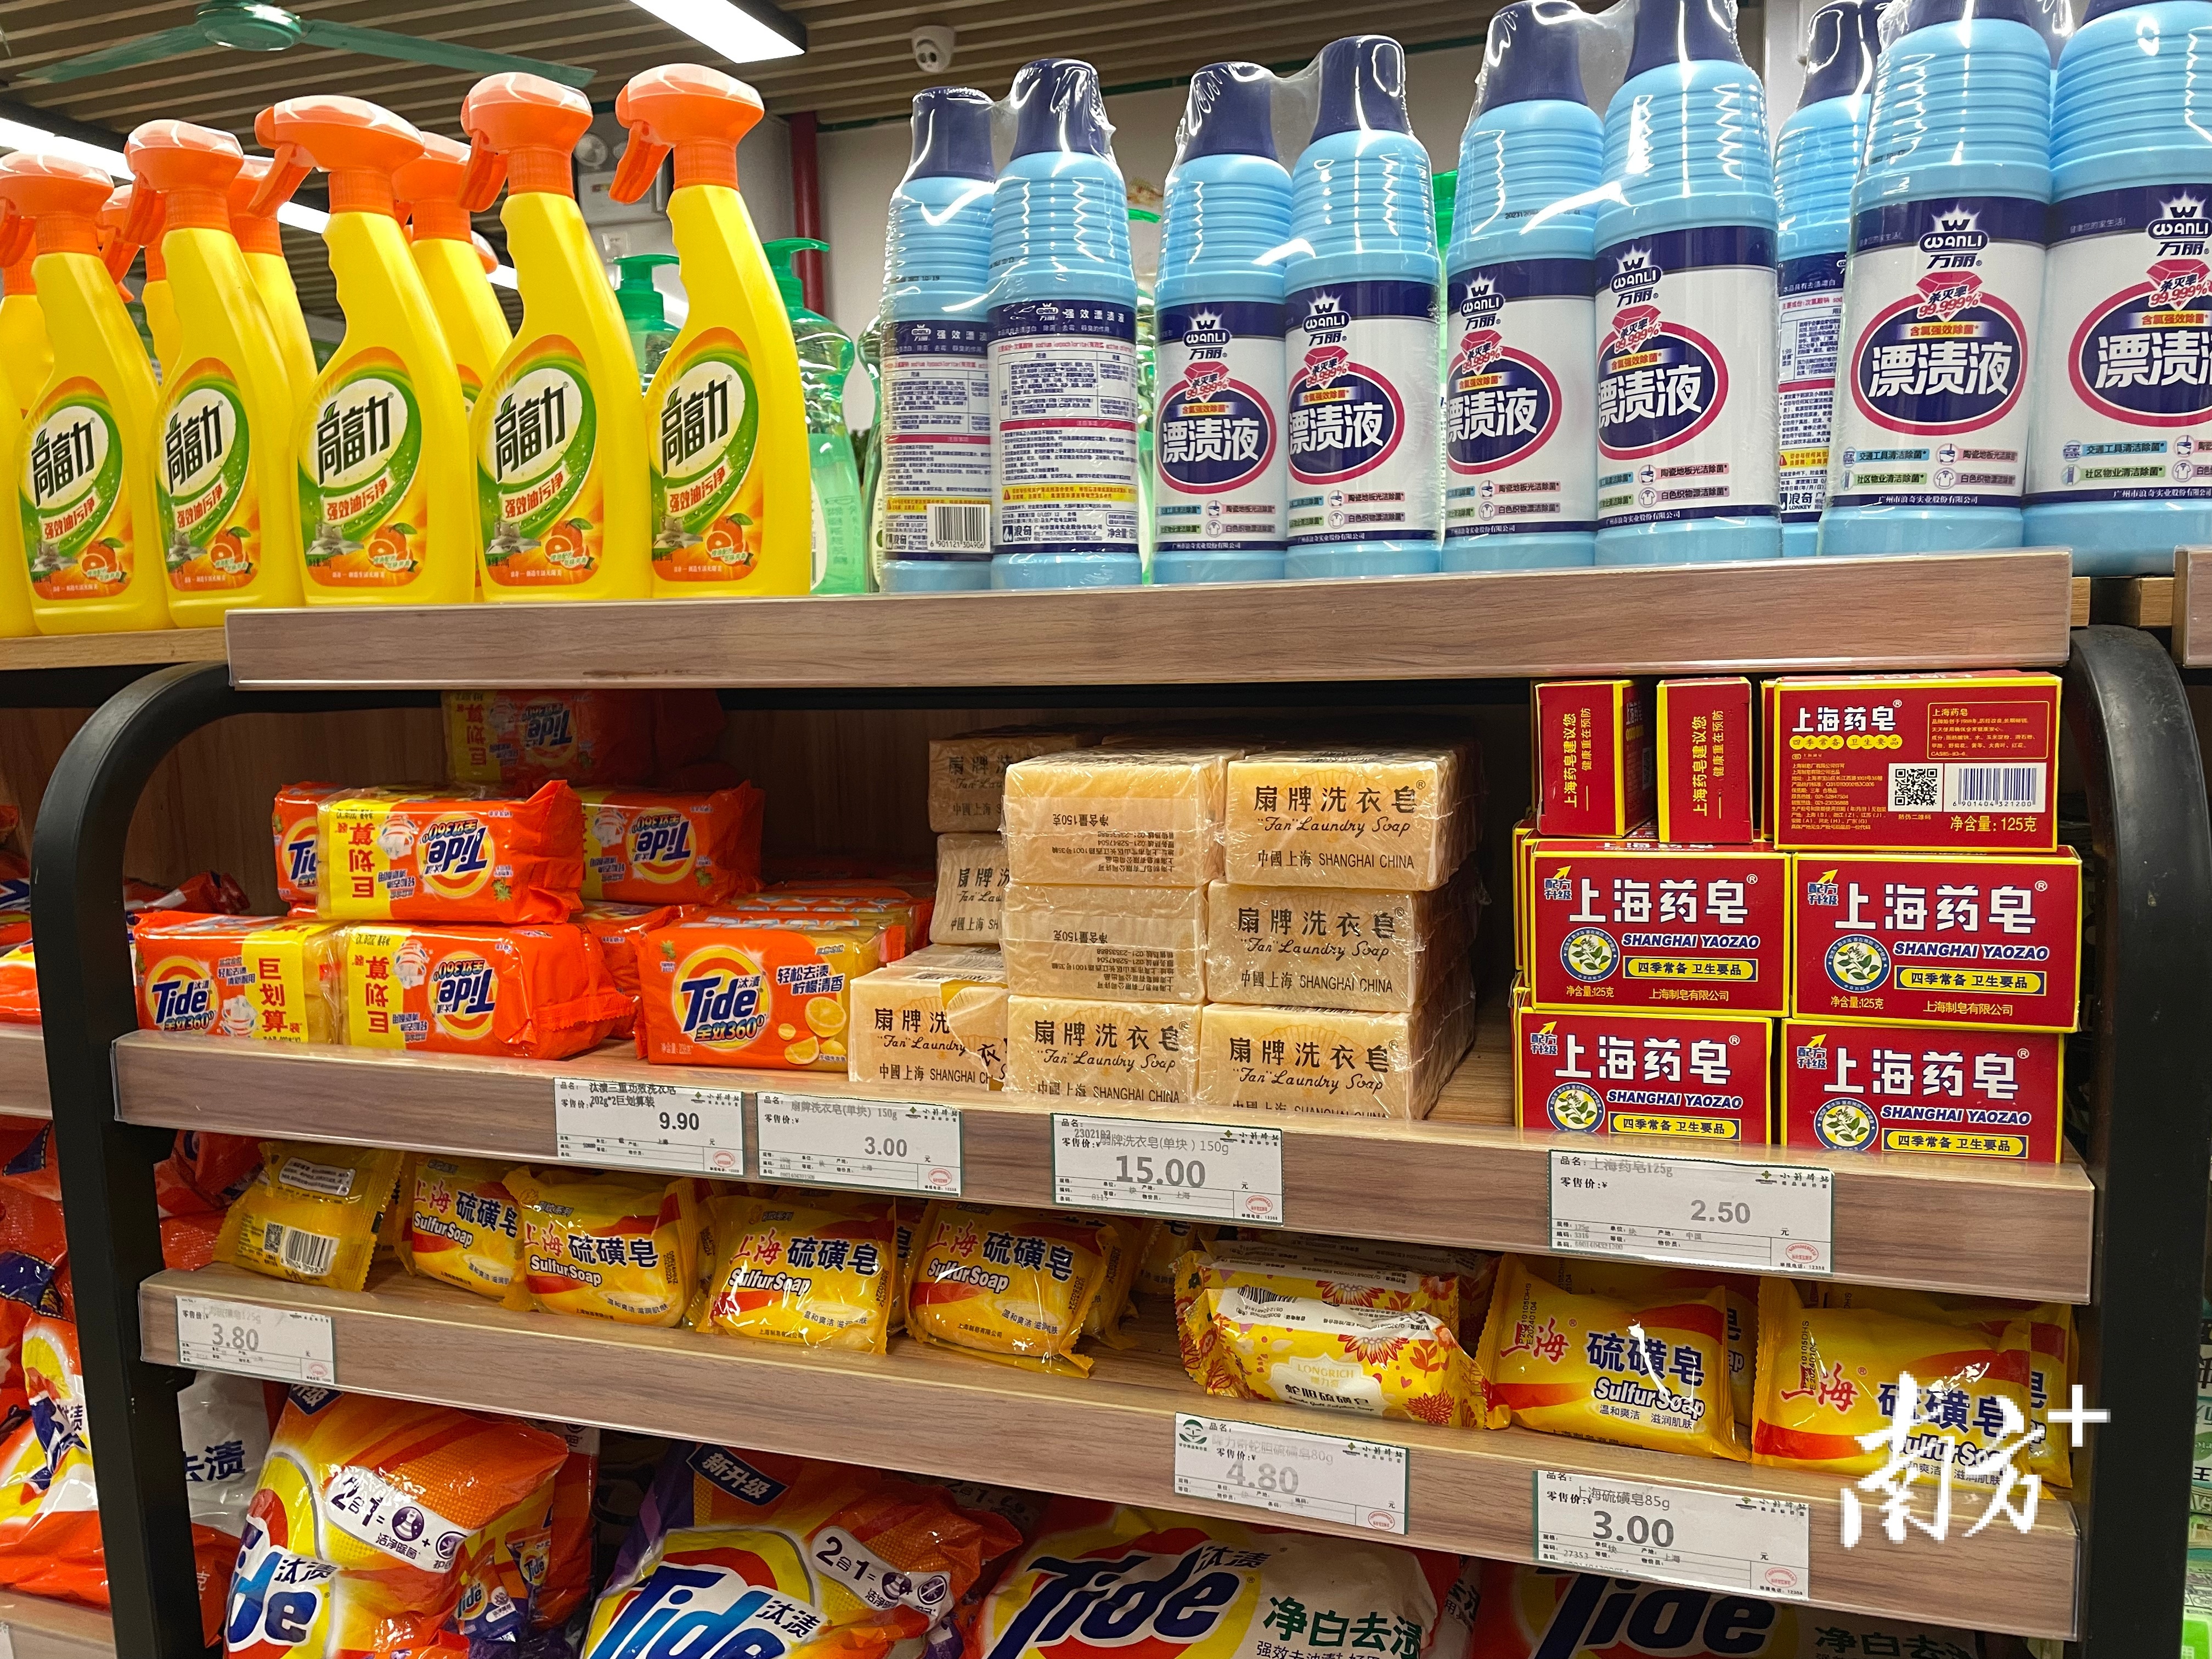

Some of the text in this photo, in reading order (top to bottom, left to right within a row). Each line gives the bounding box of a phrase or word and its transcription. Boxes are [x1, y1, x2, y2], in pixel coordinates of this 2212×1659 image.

[2153, 223, 2208, 235] WANLI
[2157, 241, 2204, 256] 万丽
[2151, 283, 2208, 305] 99.999%
[1463, 300, 1499, 314] WANLI
[1918, 295, 1979, 318] 99.999%
[1305, 314, 1347, 328] WANLI
[1186, 331, 1227, 343] WANLI
[1309, 333, 1341, 347] 万丽
[1189, 348, 1223, 360] 万丽
[1869, 342, 2012, 397] 漂渍液
[1598, 364, 1701, 429] 漂渍液
[1447, 388, 1537, 443] 漂渍液
[317, 394, 391, 485] 高富力
[494, 386, 565, 482] 高富力
[326, 477, 388, 521] 强效油污净
[504, 471, 565, 518] 强效油污净
[669, 467, 725, 512] 强效油污净
[1789, 493, 1812, 505] 浪奇
[1932, 708, 1968, 717] 上海药皂
[1581, 707, 1592, 771] 健康重在预防
[1712, 709, 1724, 777] 健康重在预防
[1849, 736, 1900, 747] 卫生要品
[1563, 713, 1577, 808] 上海药皂建议您
[1692, 715, 1707, 817] 上海药皂建议您
[1254, 785, 1417, 813] 扇牌洗衣皂
[1052, 814, 1109, 826] 净含量150克
[1298, 816, 1410, 838] Laundry Soap
[425, 827, 488, 873] Tide
[1380, 854, 1414, 869] CHINA
[1544, 878, 1572, 889] 配方
[1808, 883, 1838, 894] 配方
[1544, 889, 1572, 900] 升级
[1568, 878, 1748, 924] 上海药皂
[1808, 894, 1838, 906] 升级
[1835, 883, 2036, 934] 上海药皂
[1238, 907, 1396, 939] 扇牌洗衣皂
[1053, 930, 1108, 944] 净含量150克
[1622, 934, 1760, 949] SHANGHAI YAOZAO
[1278, 939, 1345, 961] Laundry
[1352, 940, 1389, 962] Soap
[1893, 943, 2049, 962] SHANGHAI YAOZAO
[777, 965, 830, 985] 轻松去渍
[1638, 961, 1741, 976] 四季常备 卫生要品
[1911, 972, 1966, 986] 四季常备
[439, 969, 495, 1014] Tide
[792, 975, 844, 995] 柠檬清香
[1360, 978, 1393, 994] CHINA
[1649, 988, 1729, 1002] 上海制皂有限公司
[151, 981, 210, 1024] Tide
[681, 978, 757, 1034] Tide
[1923, 1000, 2013, 1016] 上海制皂有限公司
[1034, 1020, 1179, 1052] 扇牌洗衣皂
[1531, 1034, 1557, 1045] 配方
[1229, 1037, 1390, 1073] 扇牌洗衣皂
[1531, 1044, 1558, 1056] 升级
[1555, 1034, 1731, 1085] 上海药皂
[1797, 1047, 1827, 1058] 配方
[879, 1063, 924, 1081] 中國上海
[1073, 1051, 1176, 1073] Laundry Soap
[1797, 1058, 1827, 1070] 升级
[1093, 1086, 1180, 1103] SHANGHAI CHINA
[1608, 1090, 1743, 1110] SHANGHAI YAOZAO
[659, 1111, 699, 1131] 9.90
[878, 1108, 898, 1121] 150g
[1061, 1118, 1083, 1128] 品名:
[1966, 1108, 2032, 1126] YAOZAO
[1623, 1118, 1725, 1135] 四季常备 卫生要品
[864, 1136, 907, 1157] 3.00
[1898, 1135, 1952, 1149] 四季常备
[1116, 1155, 1206, 1188] 15.00
[1560, 1156, 1587, 1166] 品名:
[1690, 1200, 1751, 1224] 2.50
[927, 1220, 979, 1259] 上海
[1780, 1227, 1790, 1236] 元
[568, 1234, 659, 1268] 硫磺皂
[787, 1237, 879, 1276] 硫磺皂
[983, 1231, 1075, 1282] 硫磺皂
[212, 1323, 259, 1352] 3.80
[1500, 1317, 1570, 1363] 上海
[1587, 1331, 1705, 1386] 硫磺皂
[1297, 1364, 1354, 1379] LONGRICH
[1780, 1363, 1859, 1412] 上海
[1599, 1404, 1692, 1431] 温和爽洁 滋润肌肤
[702, 1451, 771, 1499] 新升级
[1226, 1460, 1299, 1494] 4.80
[1388, 1500, 1396, 1509] 元
[1592, 1510, 1674, 1548] 3.00
[376, 1532, 422, 1560] 洁净除菌
[1563, 1549, 1589, 1560] 27353
[1760, 1552, 1769, 1561] 元
[816, 1536, 868, 1581] 2合1
[1194, 1546, 1269, 1574] 汰渍
[755, 1600, 821, 1635] 汰渍
